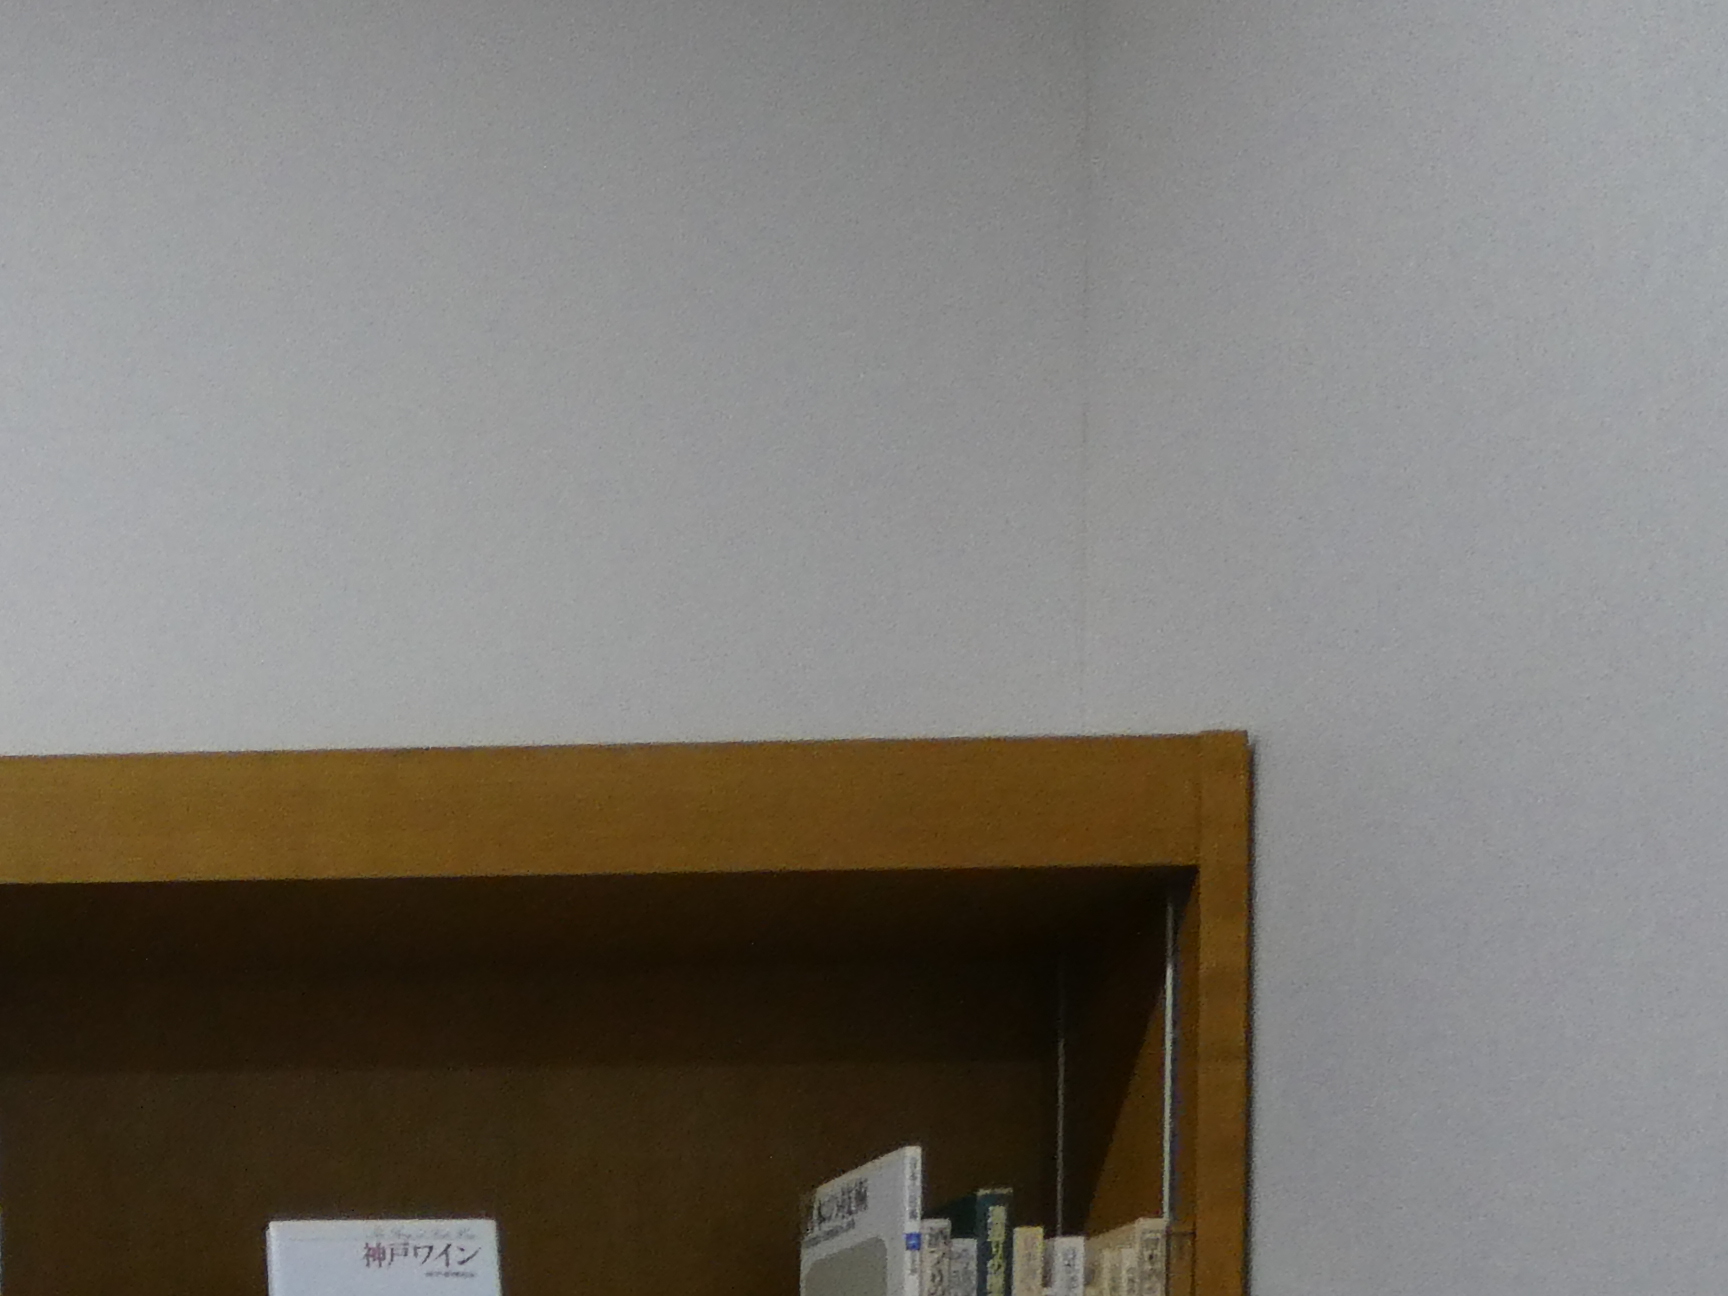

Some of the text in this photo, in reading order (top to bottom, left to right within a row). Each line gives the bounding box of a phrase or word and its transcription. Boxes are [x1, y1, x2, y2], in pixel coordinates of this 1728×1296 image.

[362, 1242, 481, 1269] 神戸ワイン
